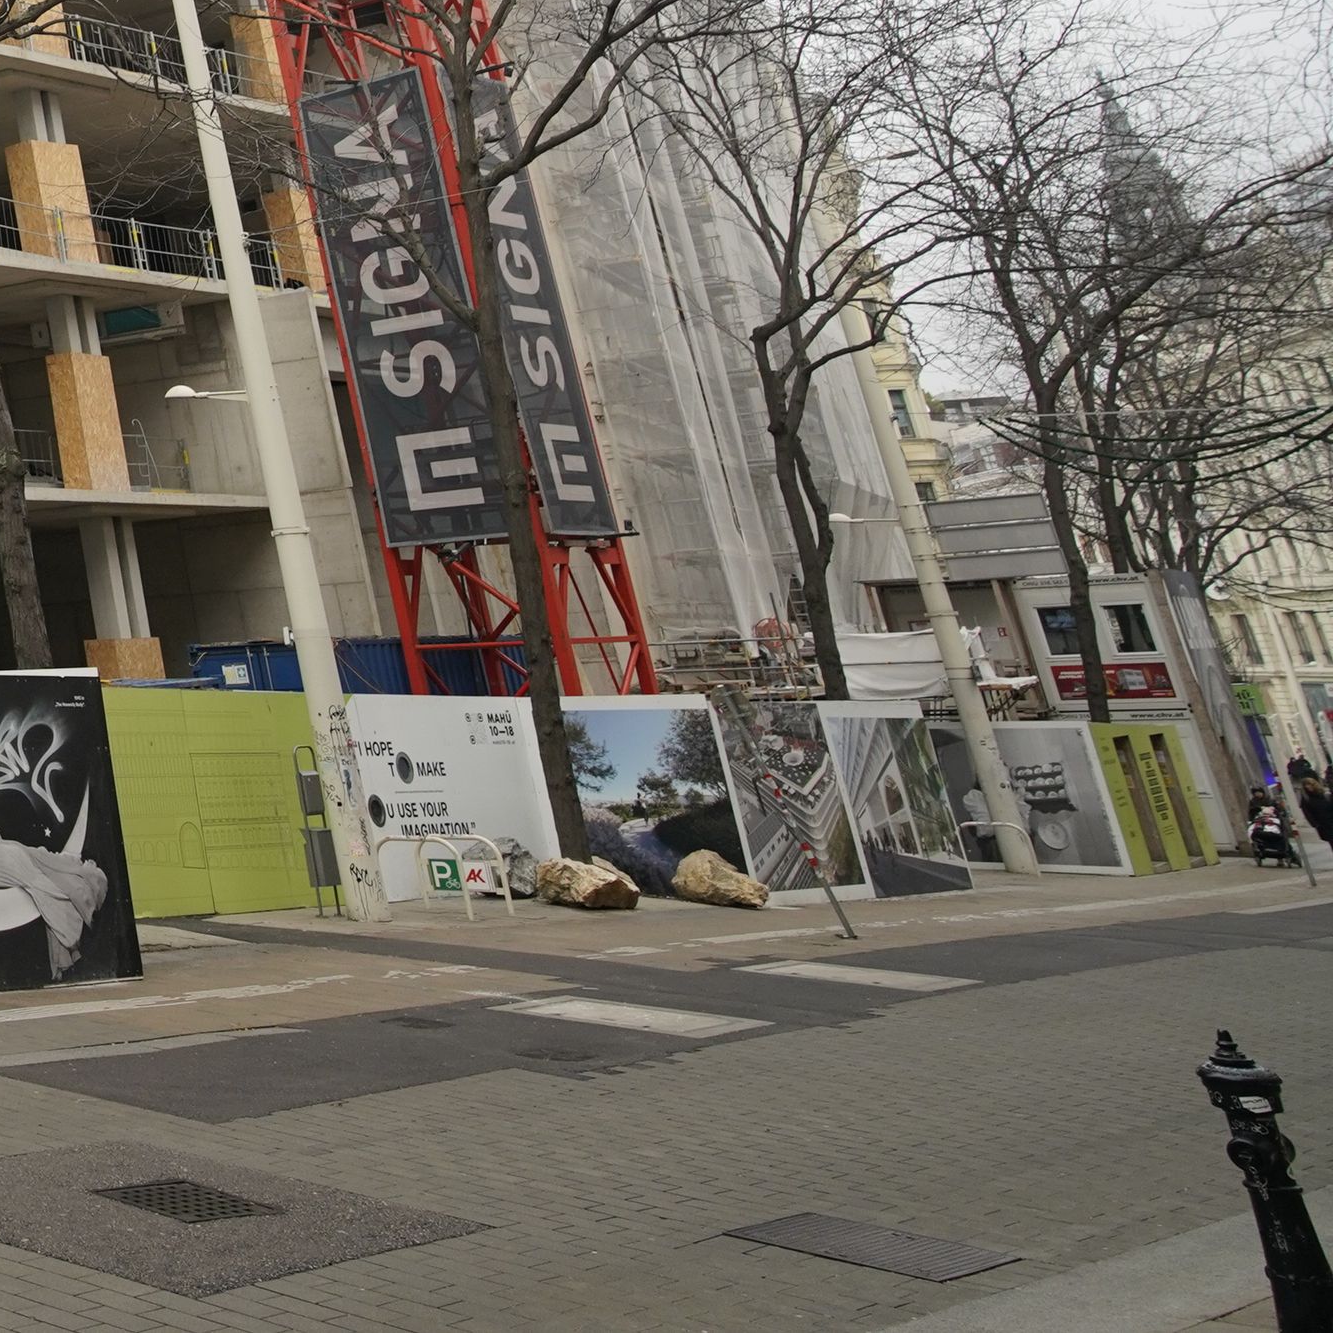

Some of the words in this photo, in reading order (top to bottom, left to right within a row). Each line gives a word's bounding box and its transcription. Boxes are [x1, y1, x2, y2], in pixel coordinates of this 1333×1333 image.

[333, 103, 457, 398] SIGNA
[366, 741, 394, 756] HOPE
[416, 761, 447, 777] MAKE
[397, 803, 418, 818] USE
[420, 802, 448, 817] YOUR
[432, 861, 452, 888] P
[466, 869, 486, 883] AK
